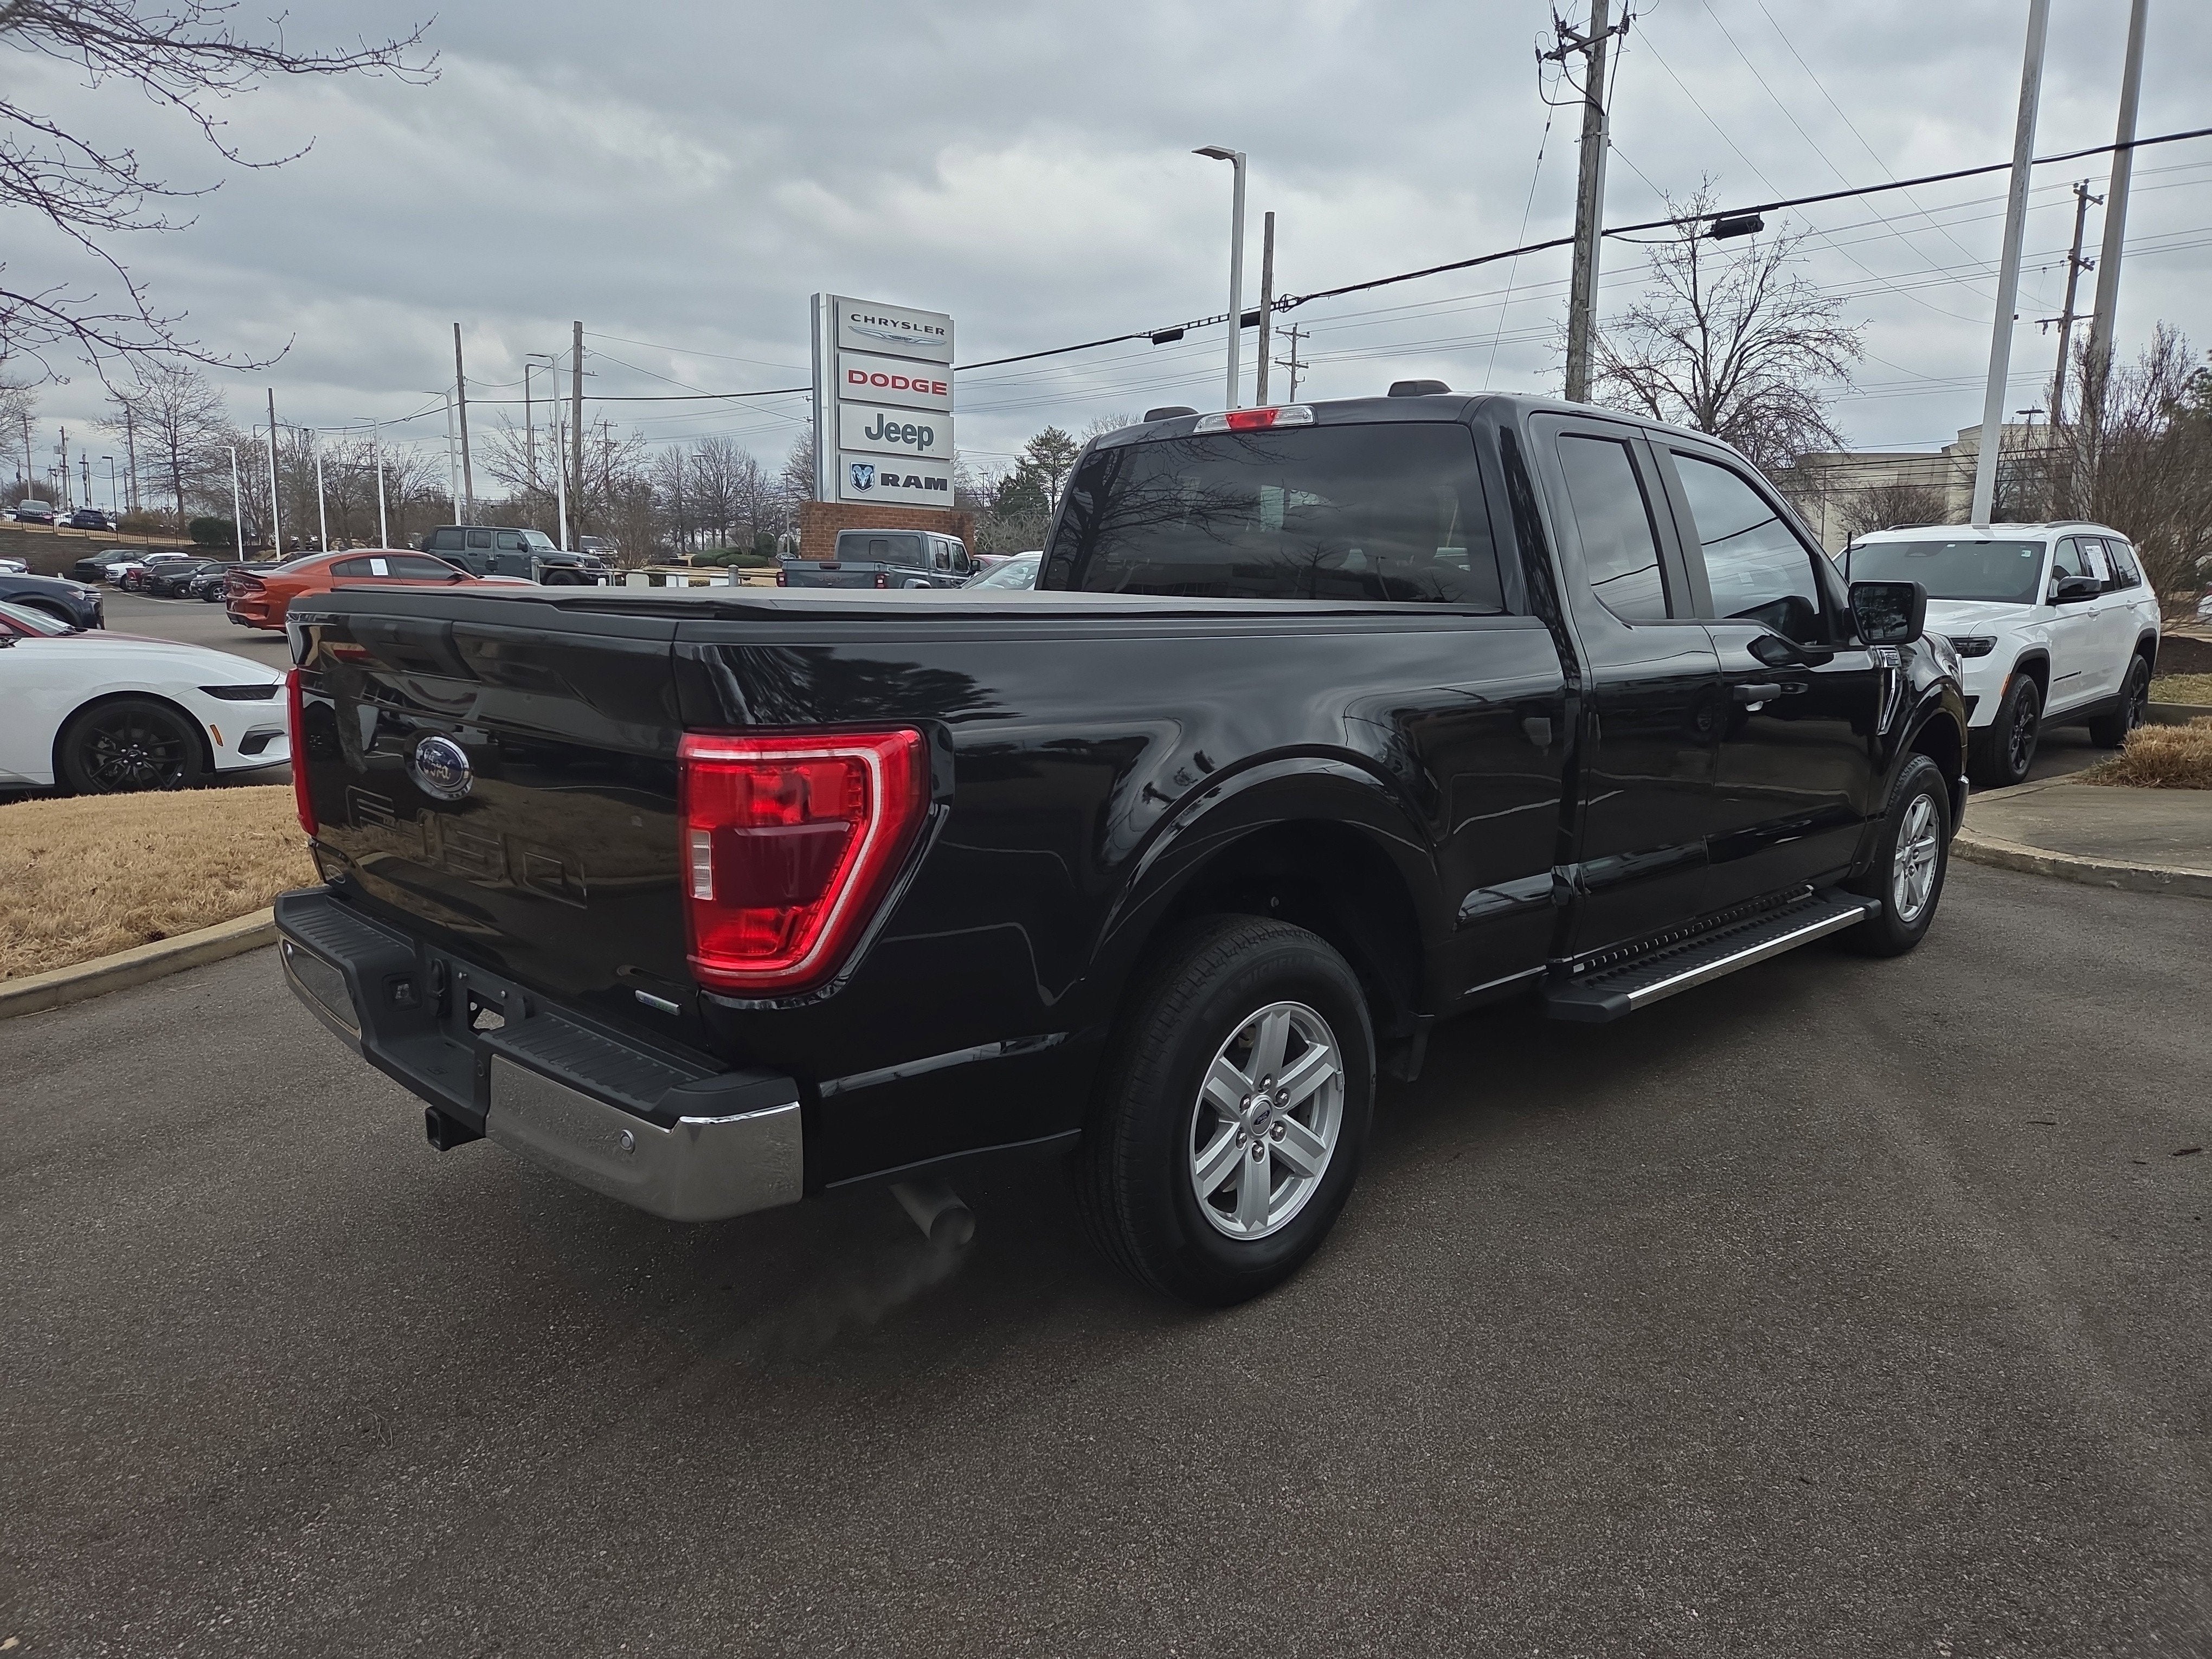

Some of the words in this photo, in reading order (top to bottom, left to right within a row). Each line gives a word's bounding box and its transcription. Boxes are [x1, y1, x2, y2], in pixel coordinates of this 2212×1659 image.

[851, 314, 945, 336] CHRYSLER
[848, 369, 947, 396] DODGE
[865, 413, 934, 451] Jeep
[880, 473, 948, 491] RAM
